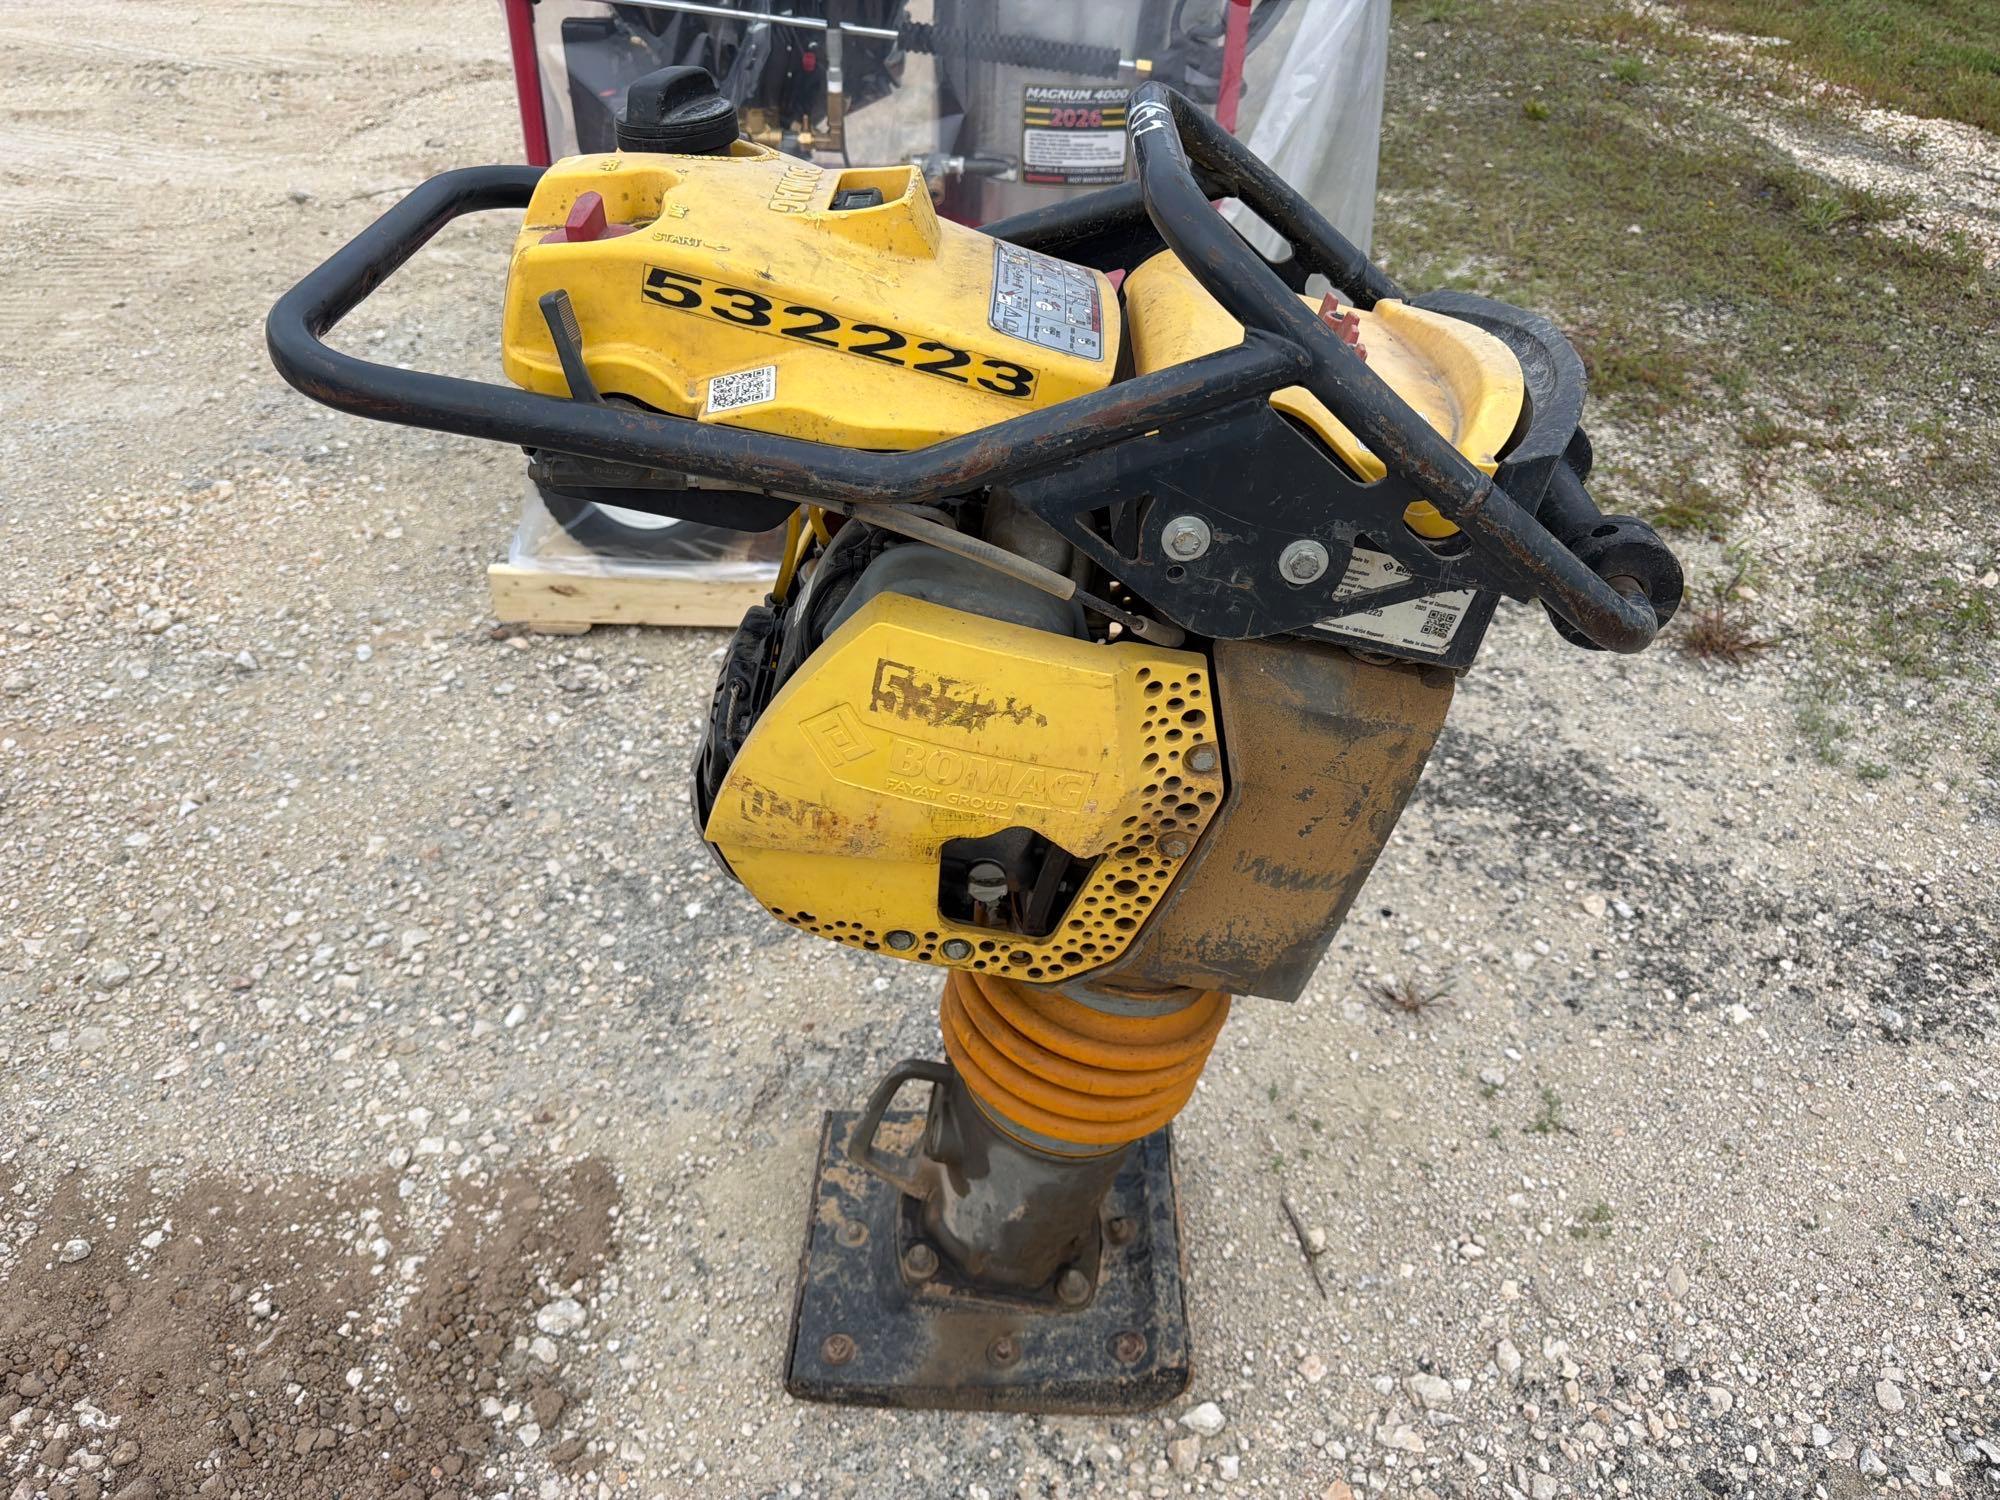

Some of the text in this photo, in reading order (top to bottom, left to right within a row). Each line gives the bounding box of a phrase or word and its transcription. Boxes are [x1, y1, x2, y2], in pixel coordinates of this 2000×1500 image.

[1026, 88, 1129, 100] MAGNUM 4000
[1050, 108, 1102, 127] 2026
[768, 165, 824, 213] BOMAG
[652, 232, 702, 248] START
[643, 268, 1034, 397] 532223
[890, 739, 1088, 809] BOMAG
[886, 778, 1009, 812] FAYAT GROUP
